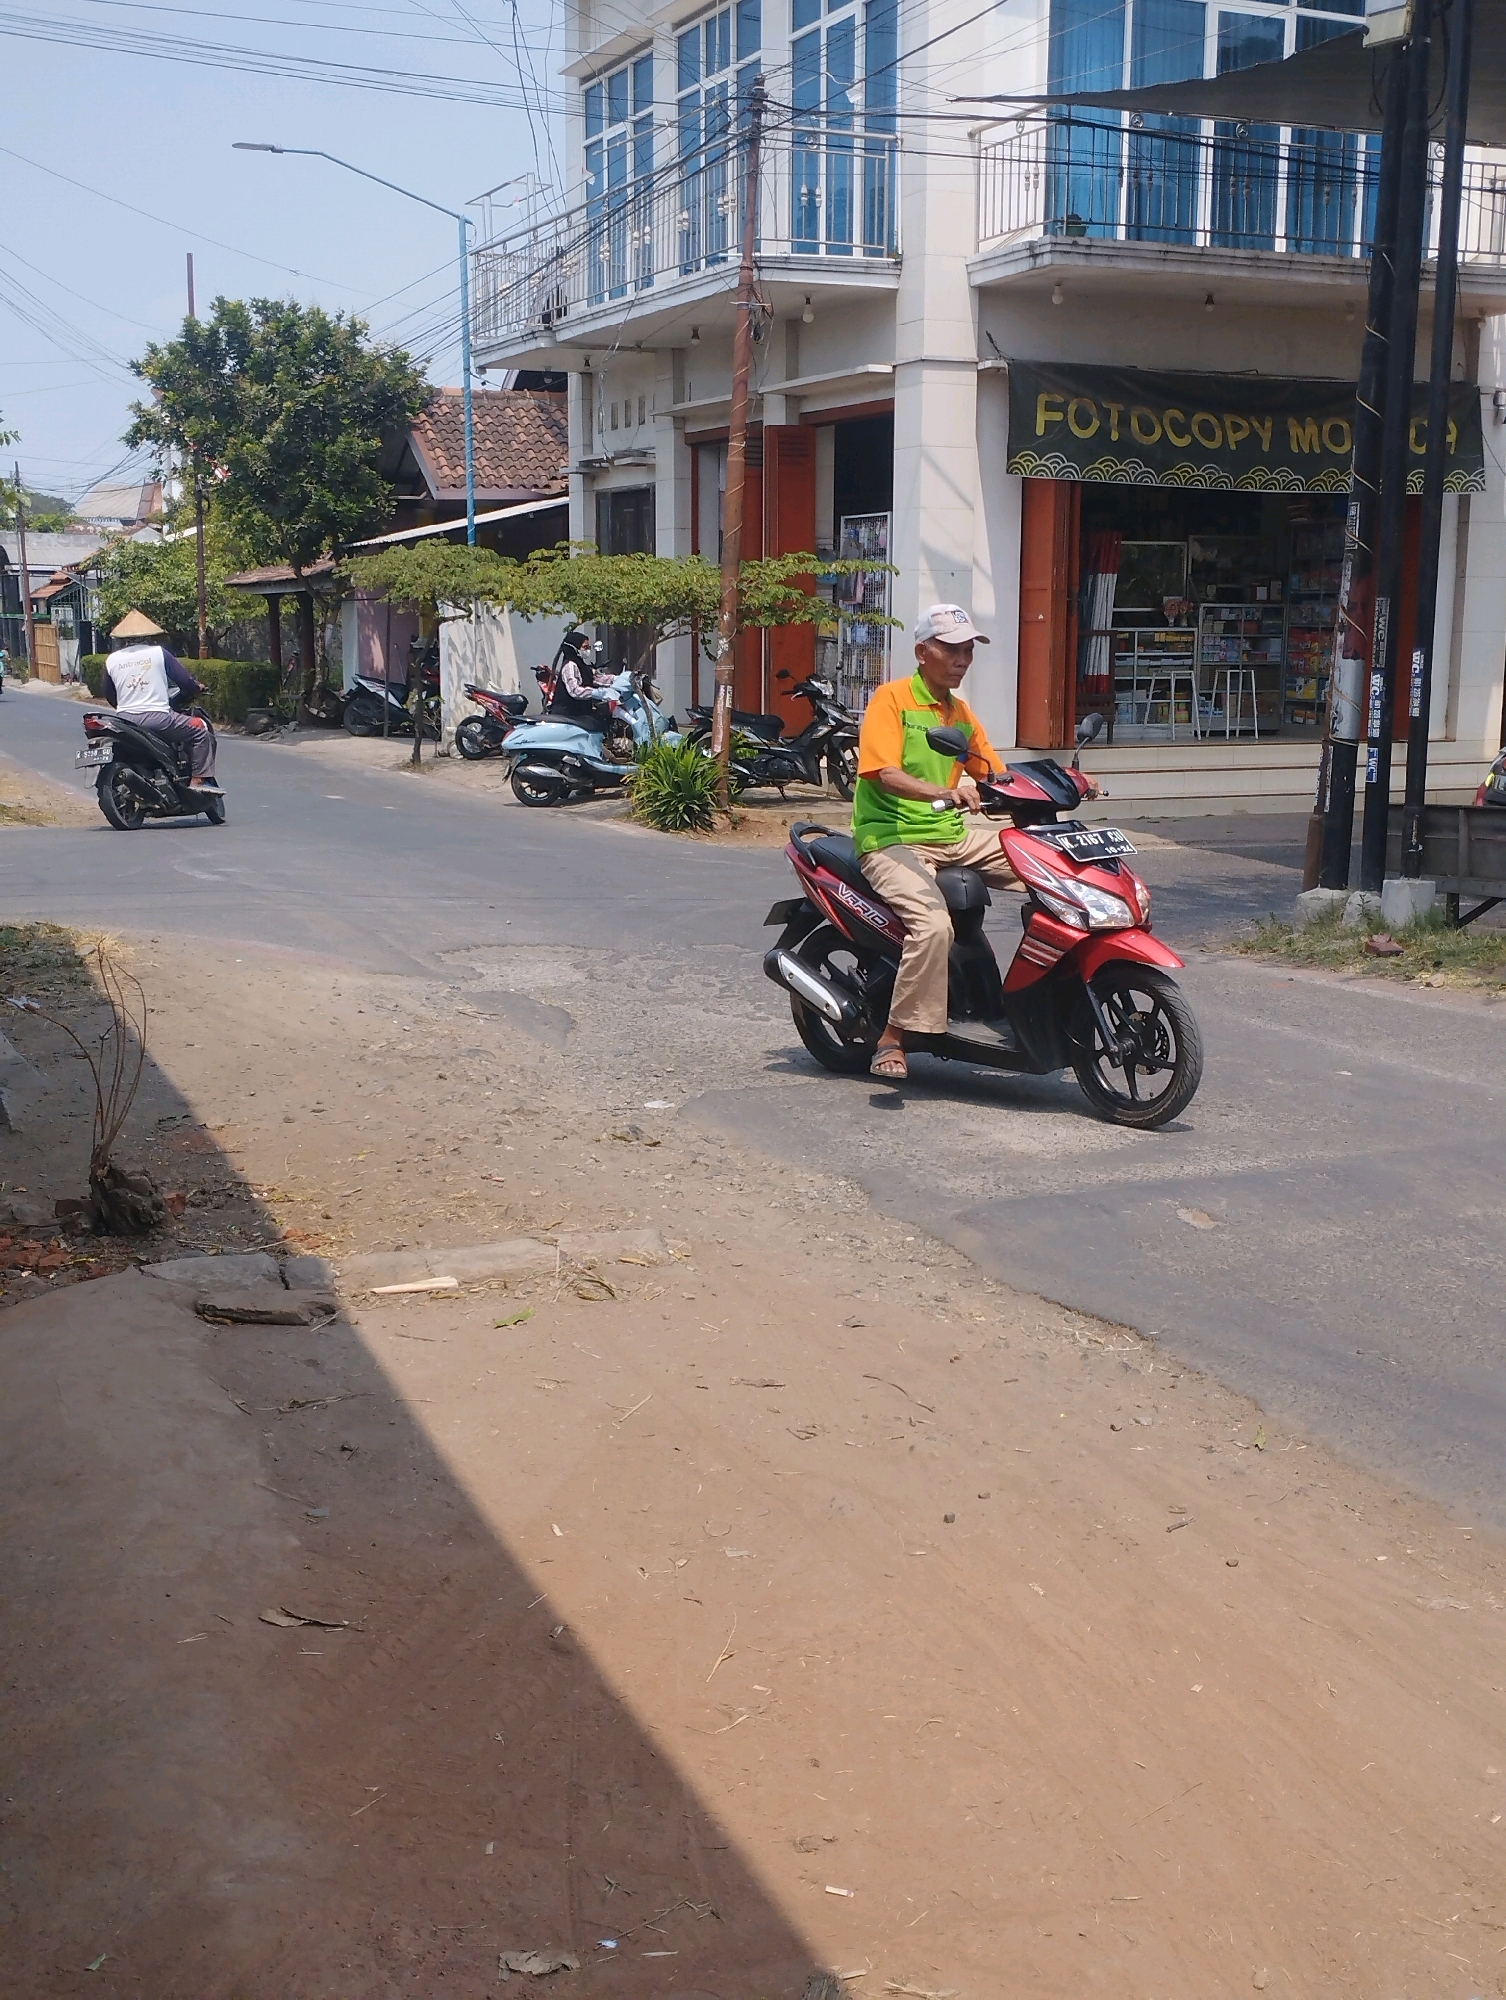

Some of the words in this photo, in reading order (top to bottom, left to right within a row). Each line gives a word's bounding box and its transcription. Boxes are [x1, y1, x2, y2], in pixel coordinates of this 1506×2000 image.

[1034, 392, 1273, 452] FOTOCOPY
[1287, 416, 1458, 456] MOCA
[118, 657, 152, 671] Antracol
[1368, 757, 1377, 773] WC
[1061, 836, 1075, 850] K
[1076, 833, 1104, 846] 2167
[838, 881, 889, 927] VARIO
